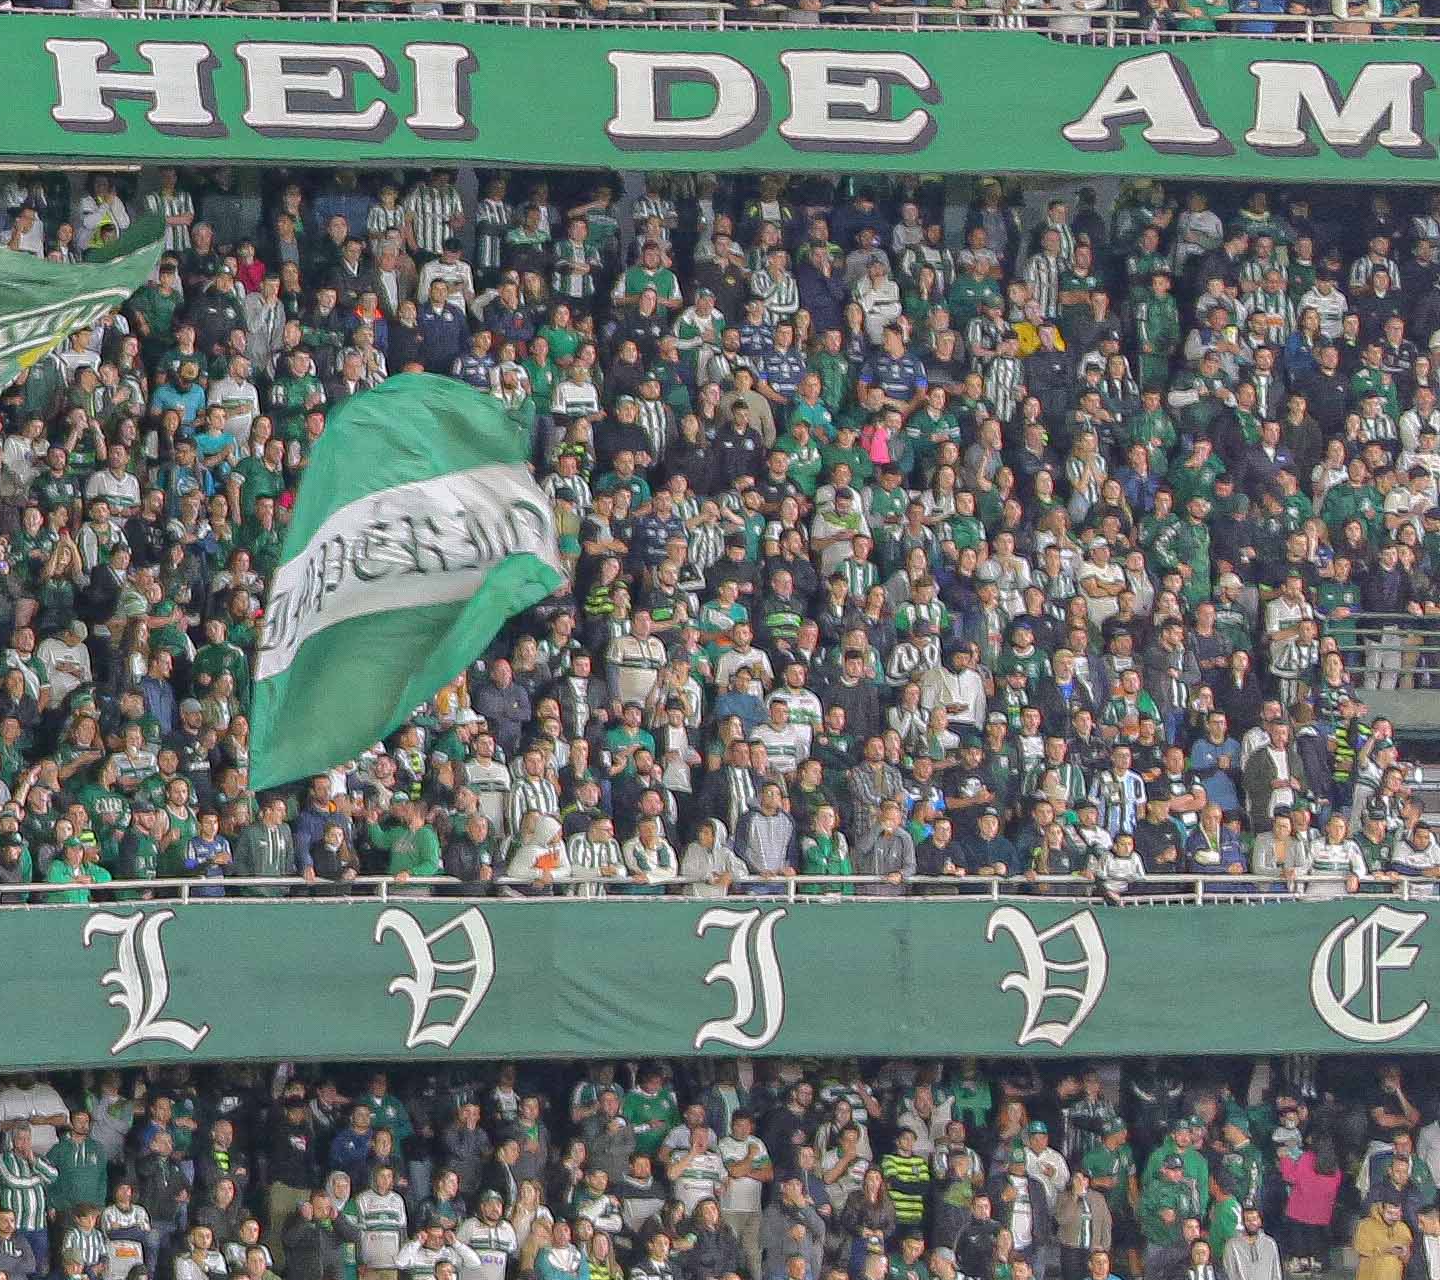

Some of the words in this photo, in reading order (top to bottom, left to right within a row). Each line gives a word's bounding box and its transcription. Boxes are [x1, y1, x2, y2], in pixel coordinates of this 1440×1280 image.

[44, 36, 481, 143] HEI
[604, 47, 937, 153] DE
[1060, 50, 1439, 160] AM
